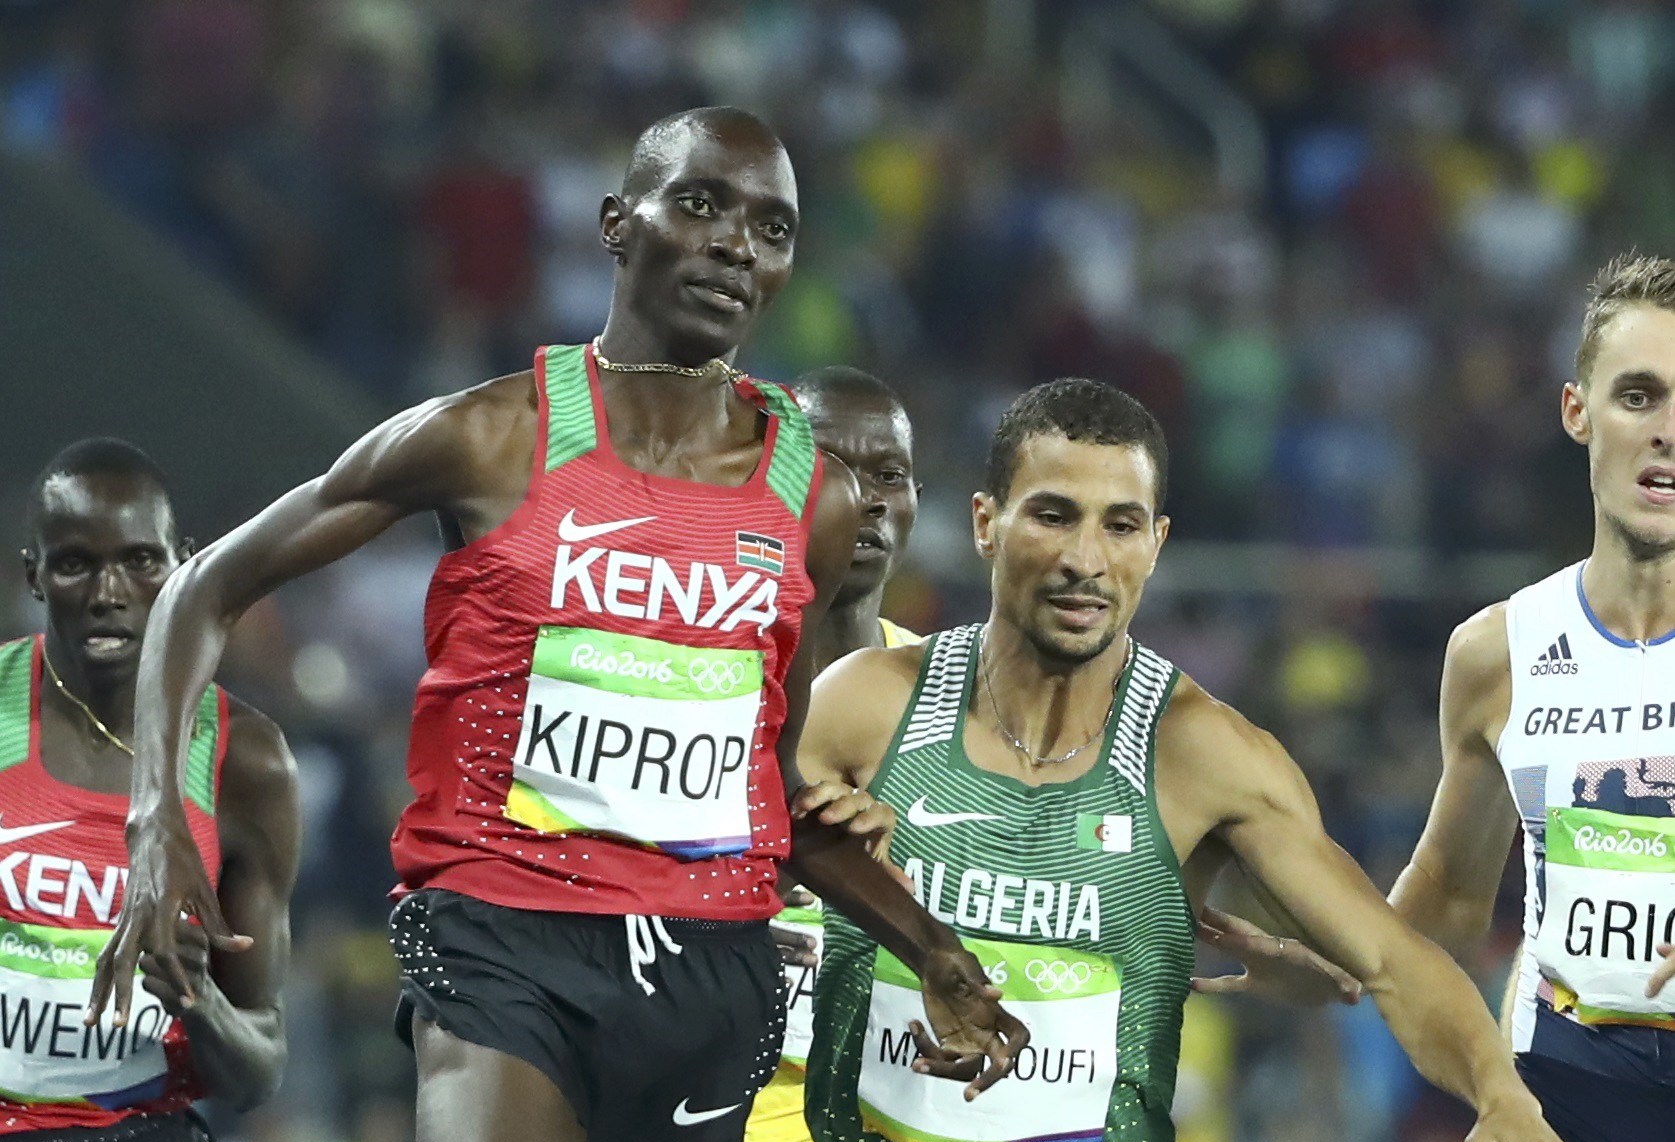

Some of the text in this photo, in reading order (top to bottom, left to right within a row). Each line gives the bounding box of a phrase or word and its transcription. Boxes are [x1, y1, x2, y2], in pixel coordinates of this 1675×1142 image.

[550, 544, 779, 637] KENYA
[1530, 659, 1578, 676] adidas
[523, 704, 746, 800] KIPROP
[1524, 702, 1675, 736] GREAT B
[0, 851, 130, 926] KEN
[904, 857, 1100, 942] ALGERIA
[879, 1028, 1095, 1084] MOUFI
